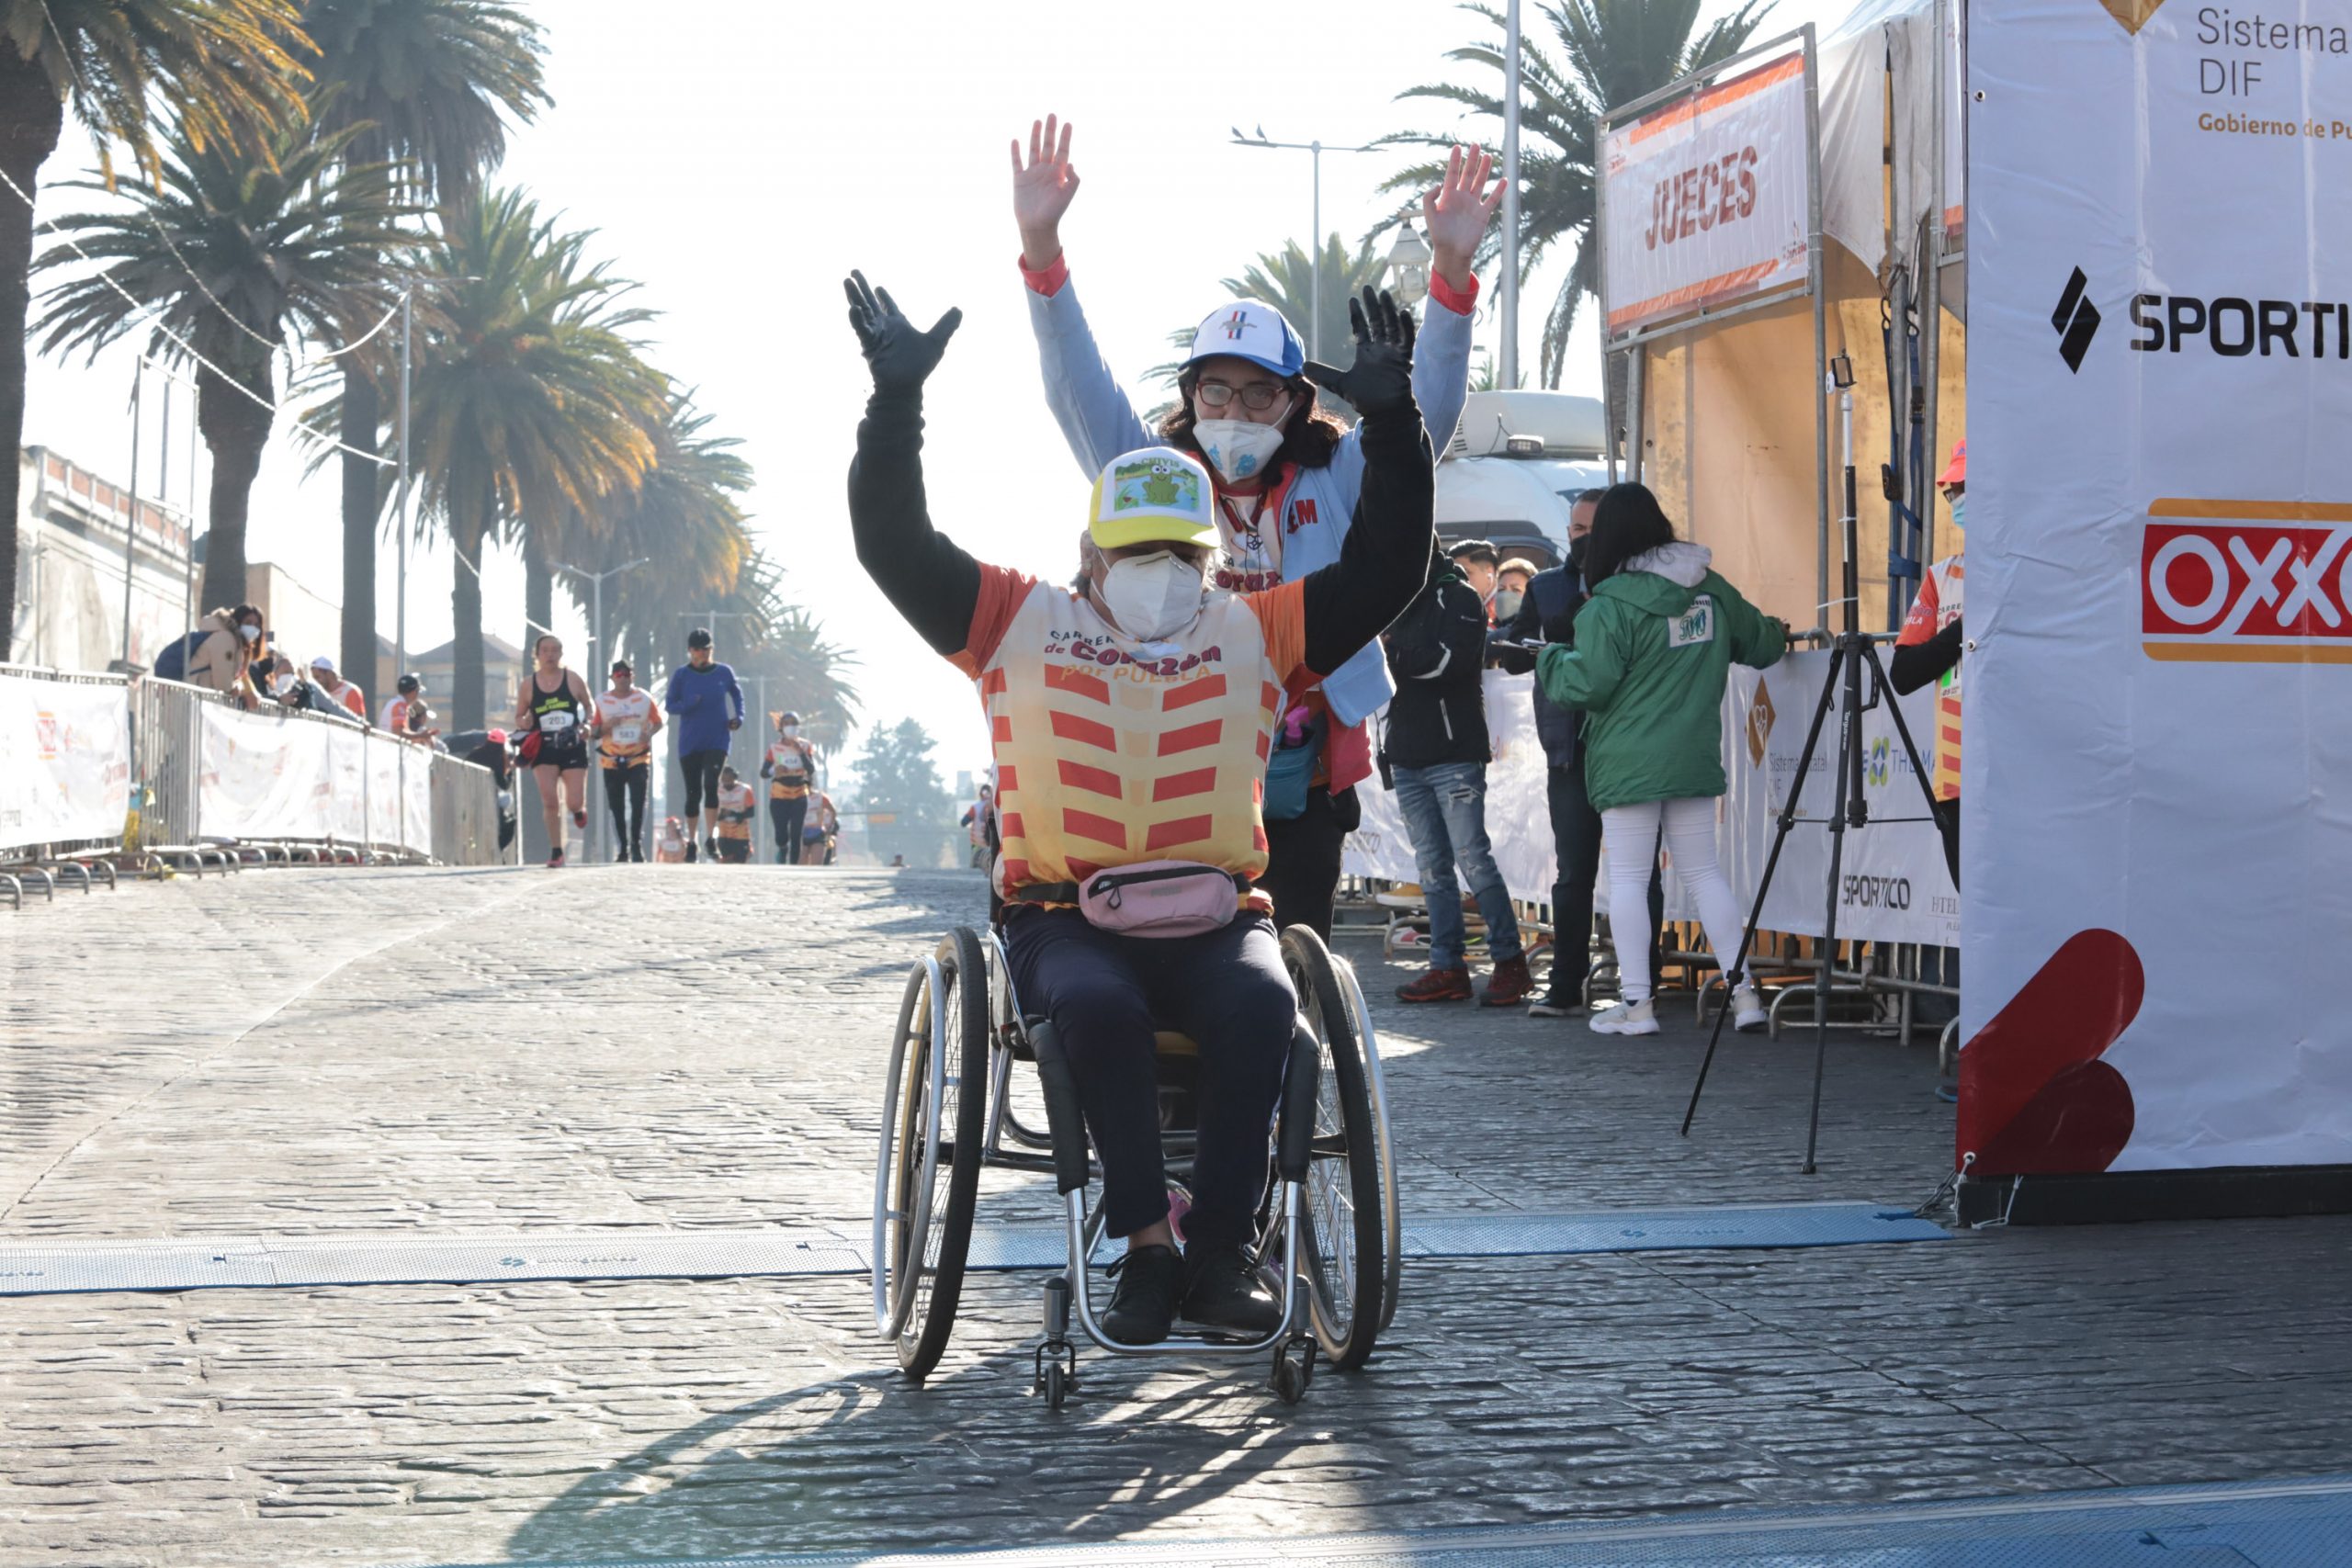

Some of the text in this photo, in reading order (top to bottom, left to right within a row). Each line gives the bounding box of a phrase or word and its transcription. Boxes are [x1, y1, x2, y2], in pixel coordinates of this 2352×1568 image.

[2197, 7, 2349, 54] Sistema
[2200, 58, 2262, 96] DIF
[2198, 113, 2297, 137] Gobierno
[2303, 118, 2325, 138] de
[1645, 145, 1758, 251] JUECES
[2130, 294, 2349, 359] SPORTI
[2148, 530, 2352, 634] OXX
[1044, 643, 1066, 654] de
[1060, 664, 1107, 682] por
